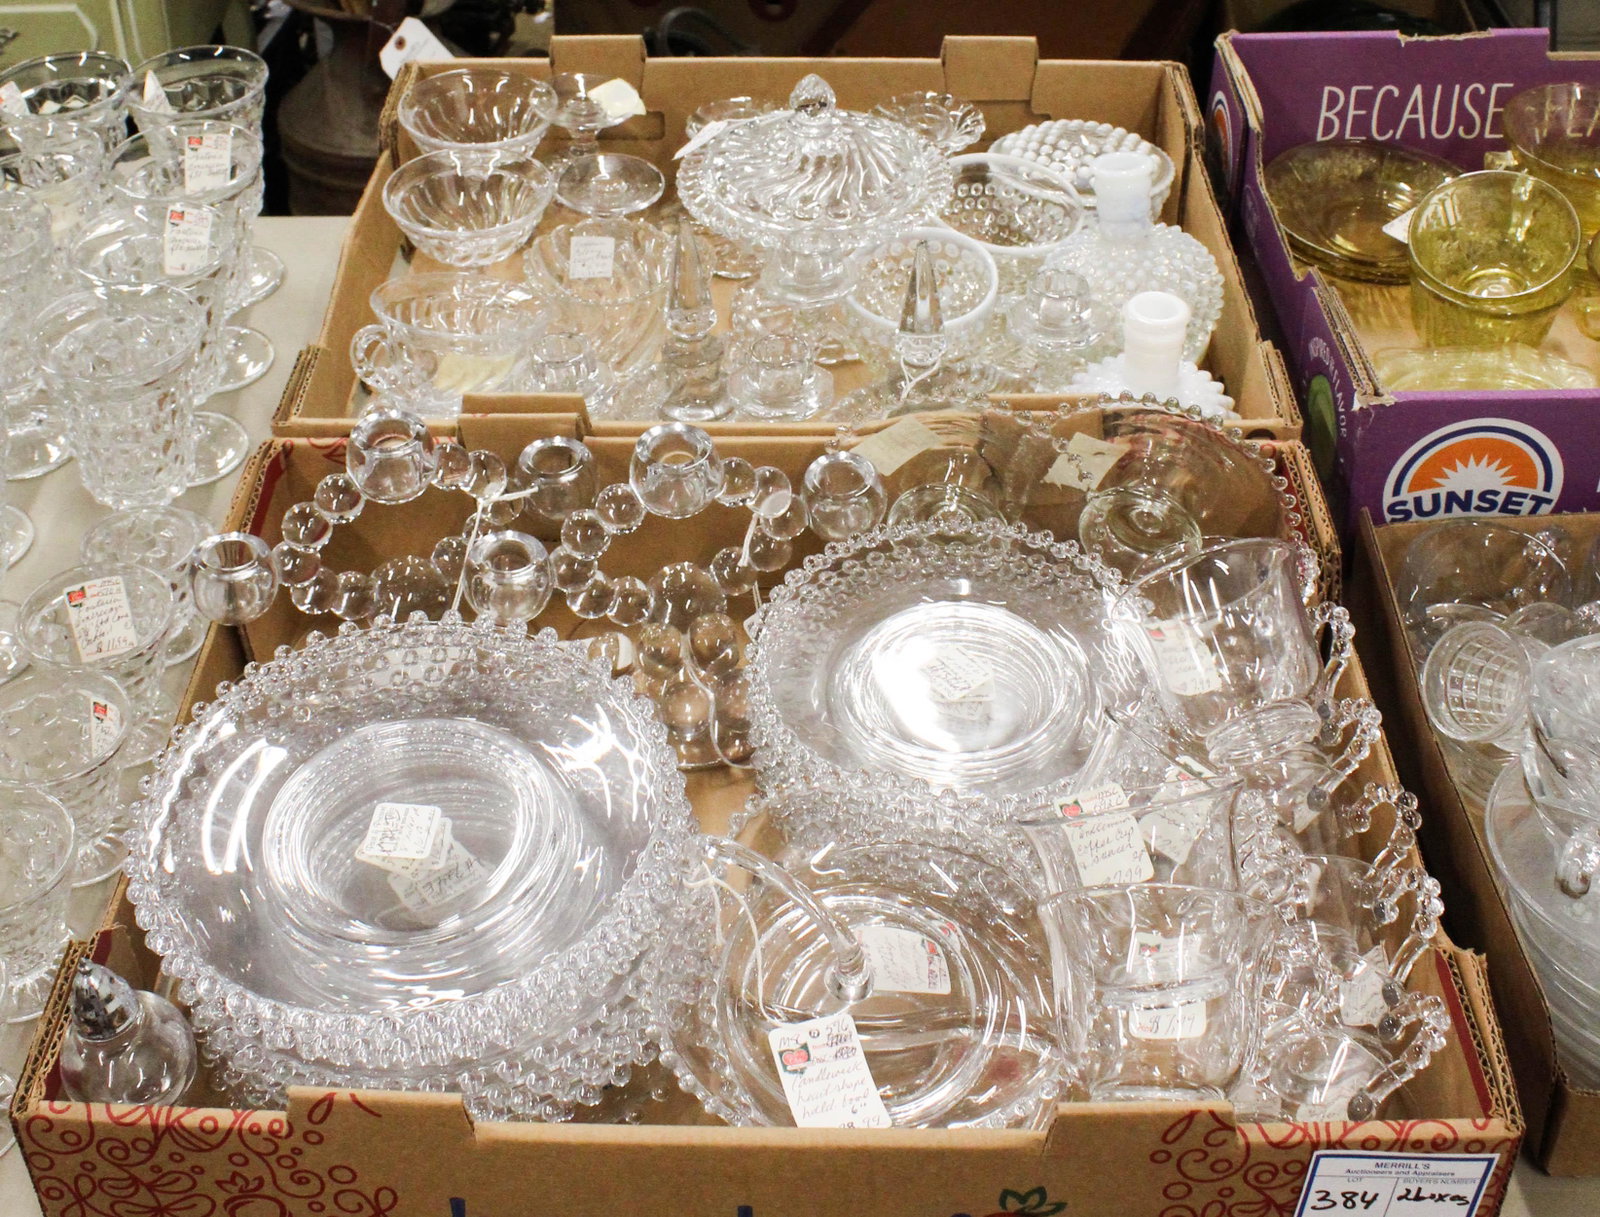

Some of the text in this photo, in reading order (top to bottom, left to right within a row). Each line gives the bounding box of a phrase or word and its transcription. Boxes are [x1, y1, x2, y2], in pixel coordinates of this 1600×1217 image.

[1316, 83, 1514, 142] BECAUSE
[1386, 489, 1553, 522] SUNSET
[1344, 1168, 1393, 1176] Auctioneers
[1411, 1170, 1456, 1178] Appraisers
[1374, 1161, 1431, 1170] MERRILL'S
[1310, 1189, 1379, 1211] 384
